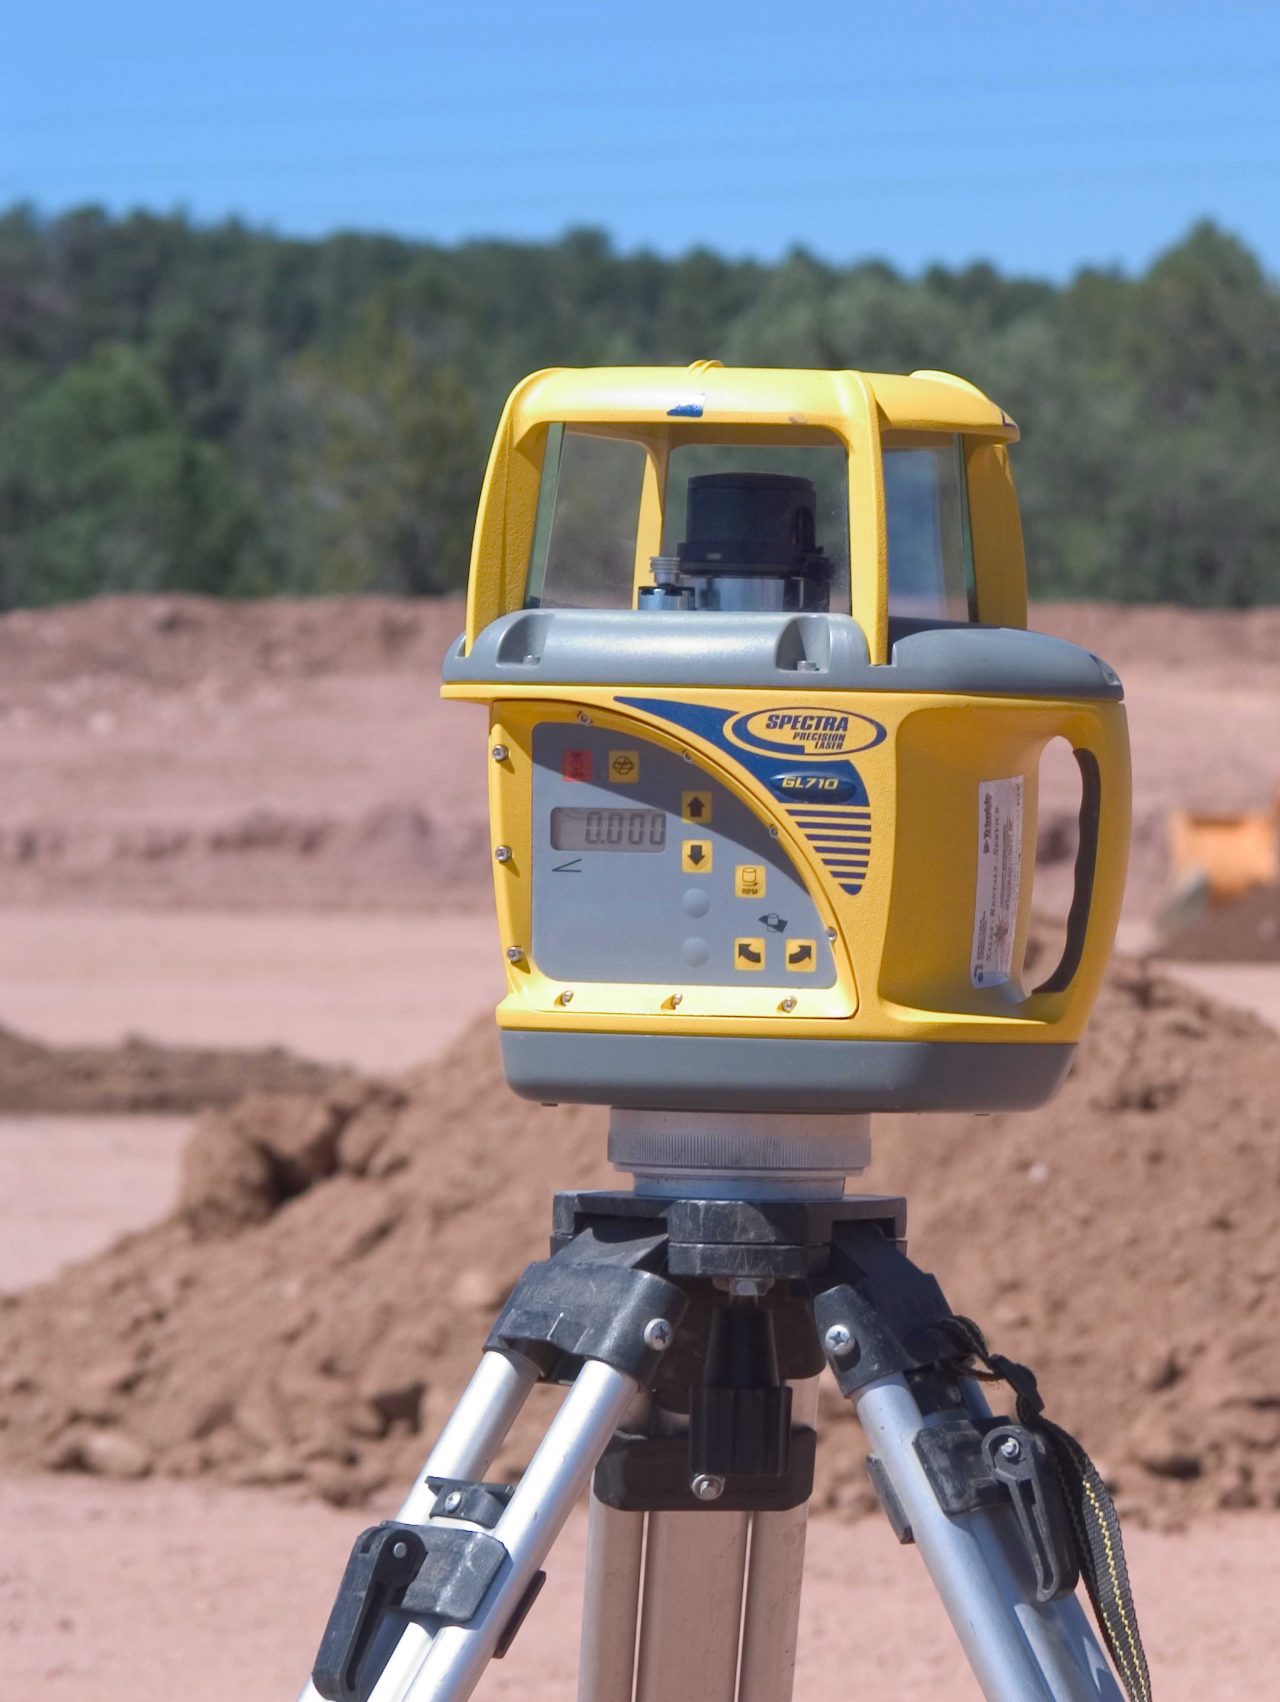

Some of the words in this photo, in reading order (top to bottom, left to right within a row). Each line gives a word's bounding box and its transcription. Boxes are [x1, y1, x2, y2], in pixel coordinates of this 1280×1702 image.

[766, 714, 849, 732] SPECTRA
[793, 732, 845, 741] PRECISION
[815, 741, 843, 749] LASER
[782, 777, 839, 789] GL710
[983, 793, 993, 840] Trimble
[585, 811, 667, 845] 0.000
